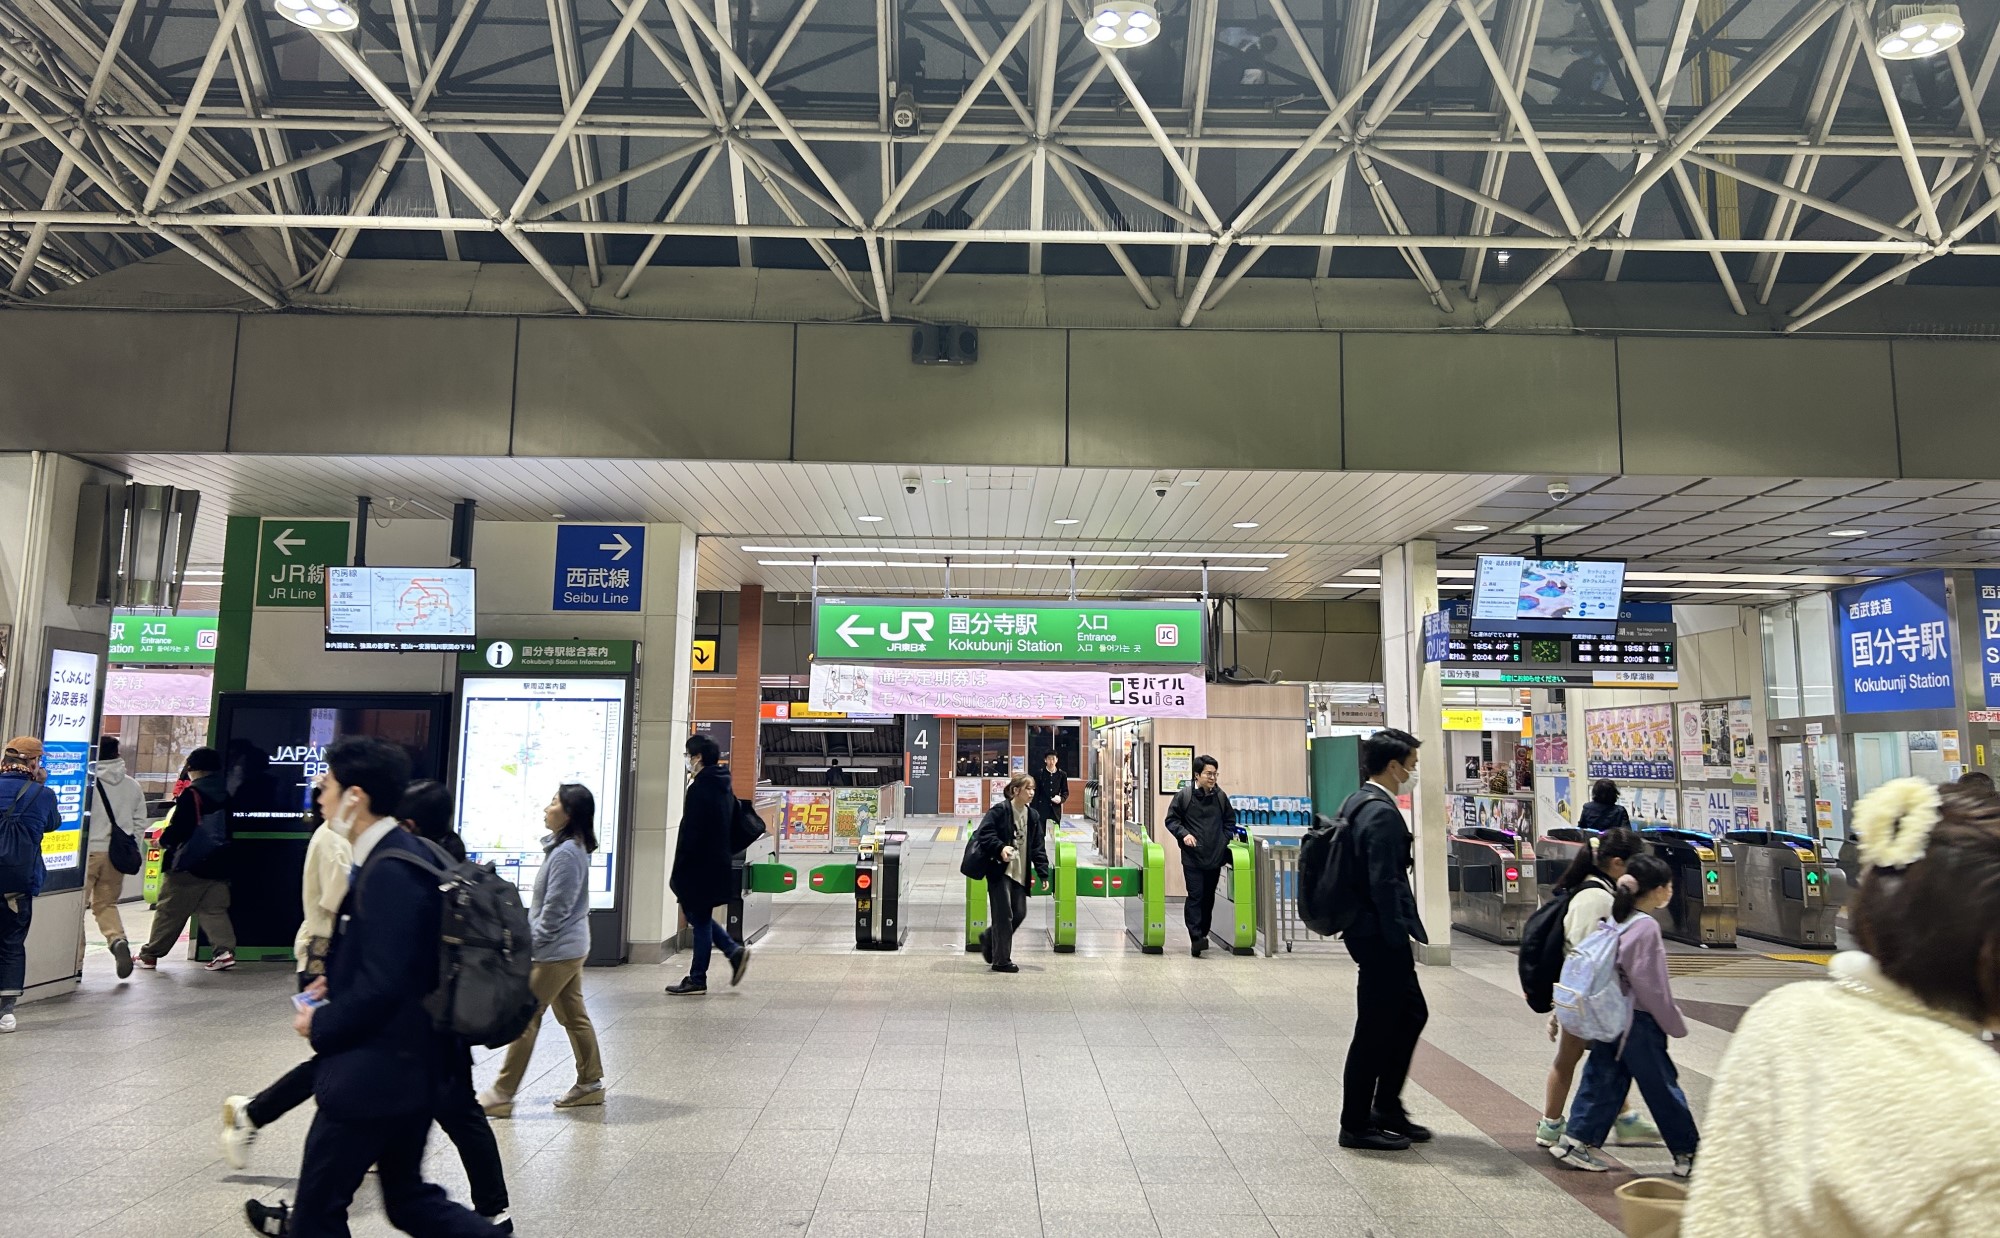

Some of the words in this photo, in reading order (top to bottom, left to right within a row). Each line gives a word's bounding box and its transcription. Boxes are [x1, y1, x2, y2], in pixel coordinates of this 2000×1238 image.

[270, 563, 325, 584] JR線
[331, 569, 358, 577] 内房線
[566, 567, 630, 588] 西武線
[268, 588, 286, 599] JR
[290, 588, 317, 599] Line
[563, 592, 599, 603] Seibu
[602, 593, 629, 604] Line
[1849, 598, 1893, 620] 西武鉄道
[880, 611, 934, 641] JR
[948, 613, 1038, 636] 国分寺駅
[1077, 614, 1108, 630] 入口
[1424, 610, 1450, 637] 西武線
[141, 623, 167, 635] 入口
[1161, 631, 1173, 640] JC
[140, 636, 173, 645] Entrance
[201, 635, 213, 644] JC
[1077, 632, 1117, 642] Entrance
[140, 645, 153, 653] 入口
[886, 643, 927, 652] JR東日本
[948, 638, 1014, 654] Kokubunji
[1017, 639, 1063, 653] Station
[1077, 645, 1093, 653] 入口
[1133, 644, 1142, 654] 곳
[1426, 636, 1447, 660] のりば
[1623, 644, 1645, 652] 19:59
[1851, 620, 1948, 668] 国分寺駅
[521, 646, 609, 658] 国分寺駅総合案内
[1472, 653, 1493, 661] 20:04
[521, 658, 554, 666] Kokubunji
[1623, 655, 1645, 663] 20:09
[53, 669, 92, 685] こくぶんじ
[877, 669, 988, 687] 通学定期券は
[1447, 670, 1480, 679] 国分寺線
[1622, 672, 1655, 681] 多摩湖線
[106, 675, 145, 691] 券は
[523, 682, 567, 690] 駅周辺案内図
[1127, 677, 1186, 690] モバイル
[1854, 674, 1907, 694] Kokubunji
[1908, 673, 1950, 691] Station
[50, 690, 88, 708] 泌尿器科
[877, 691, 1101, 711] モバイルSuicaがおすすめ！
[1128, 691, 1186, 706] Suica
[48, 713, 86, 728] クリニック
[913, 729, 929, 749] 4
[1708, 792, 1730, 810] ALL
[790, 803, 830, 826] 35
[148, 850, 160, 861] IC
